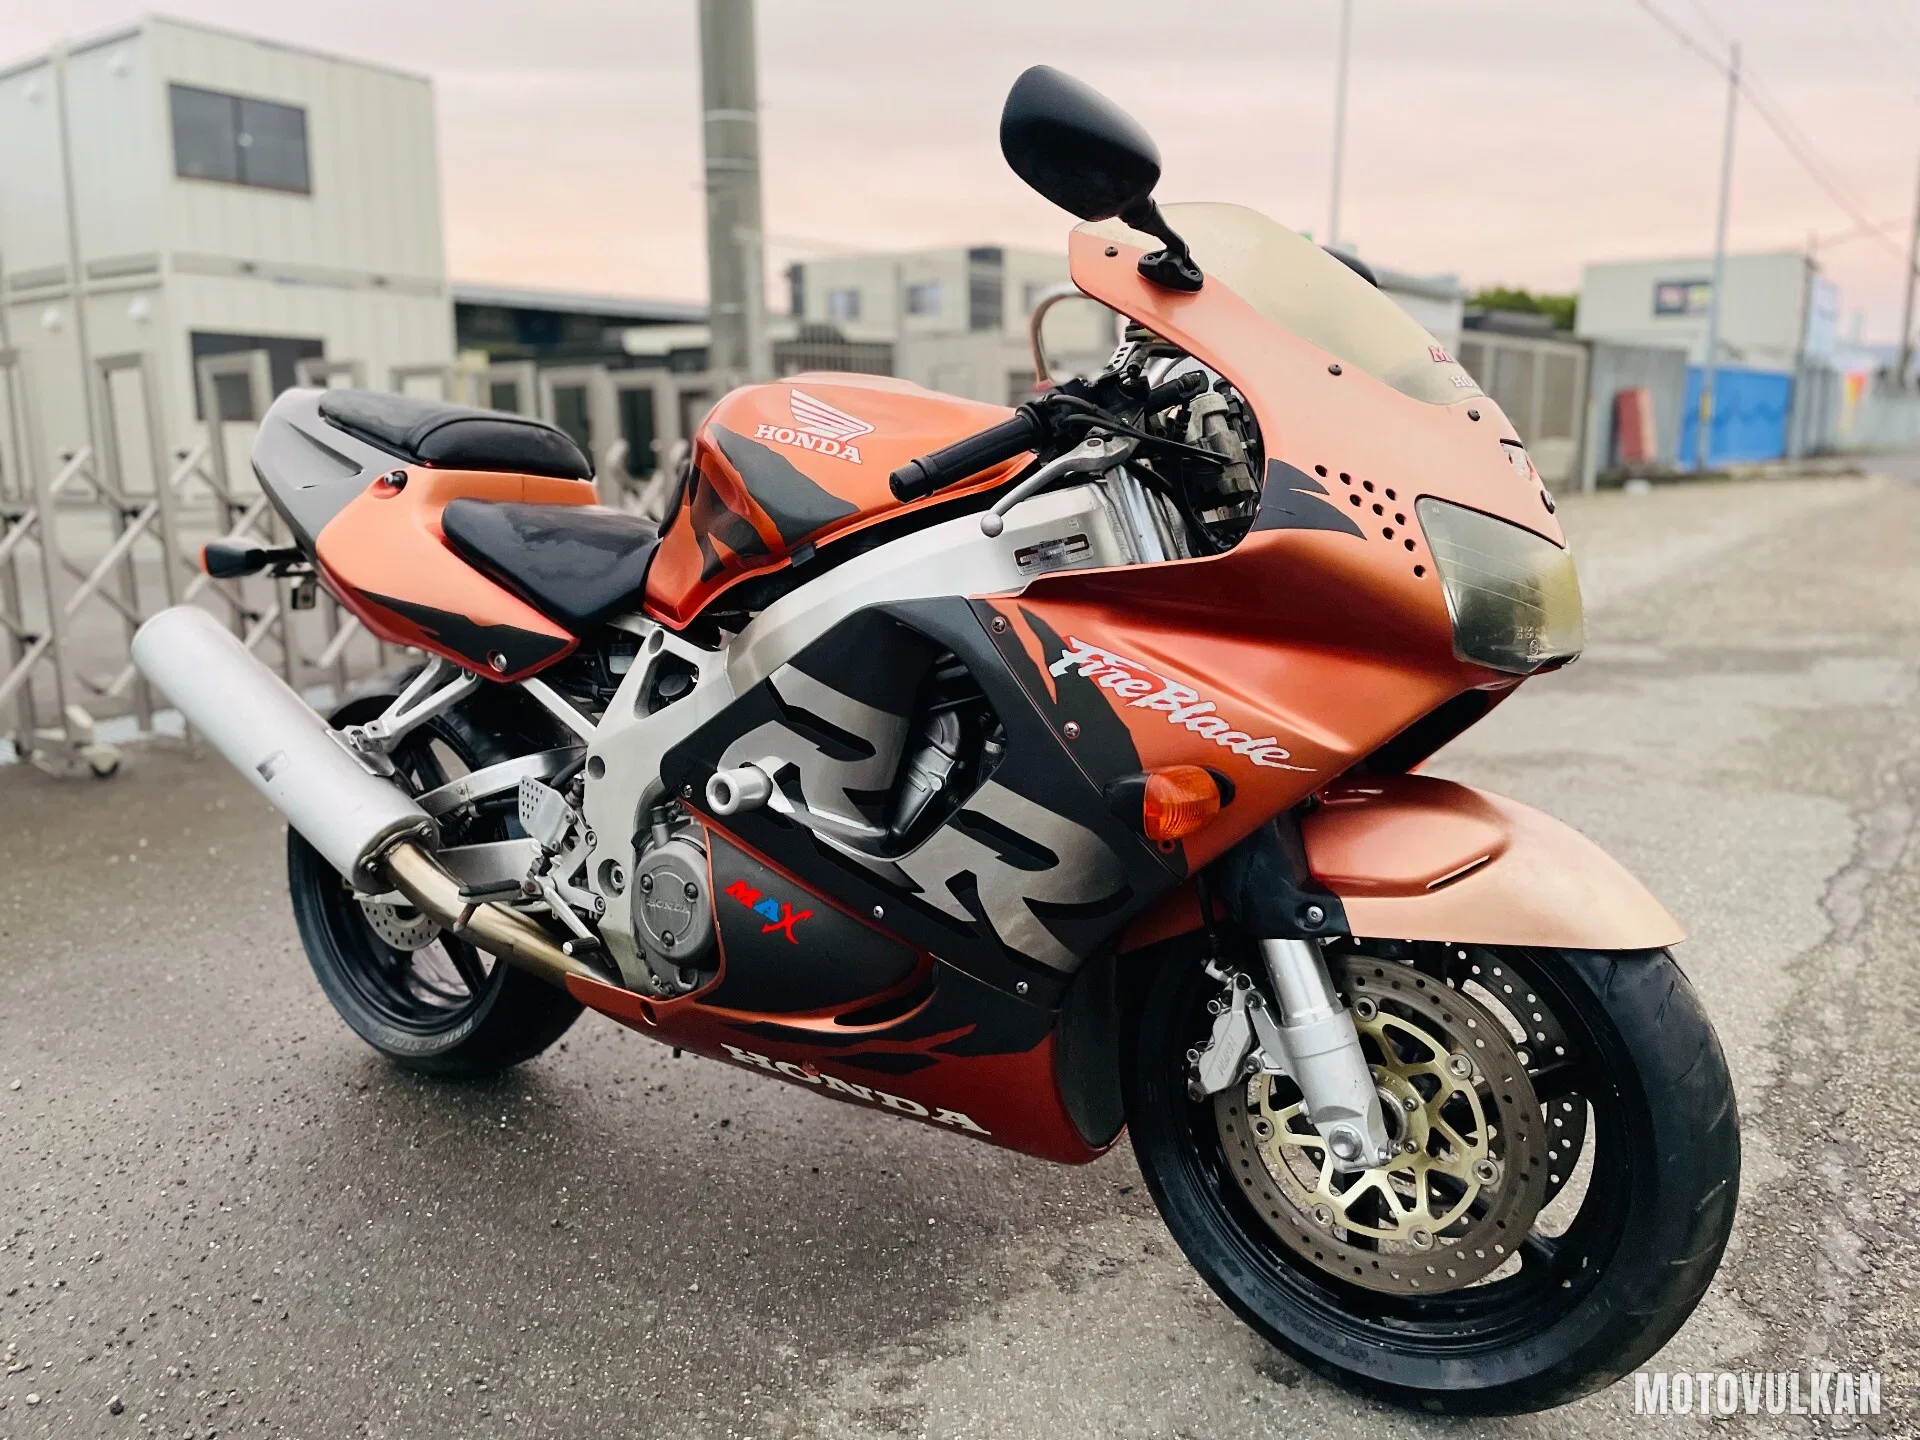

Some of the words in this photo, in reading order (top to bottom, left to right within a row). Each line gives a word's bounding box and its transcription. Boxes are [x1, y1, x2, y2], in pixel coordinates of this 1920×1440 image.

[755, 424, 862, 464] HONDA
[1049, 635, 1318, 772] FireBlade
[717, 663, 1125, 973] RR
[724, 879, 814, 945] MAX
[720, 1043, 991, 1136] HONDA
